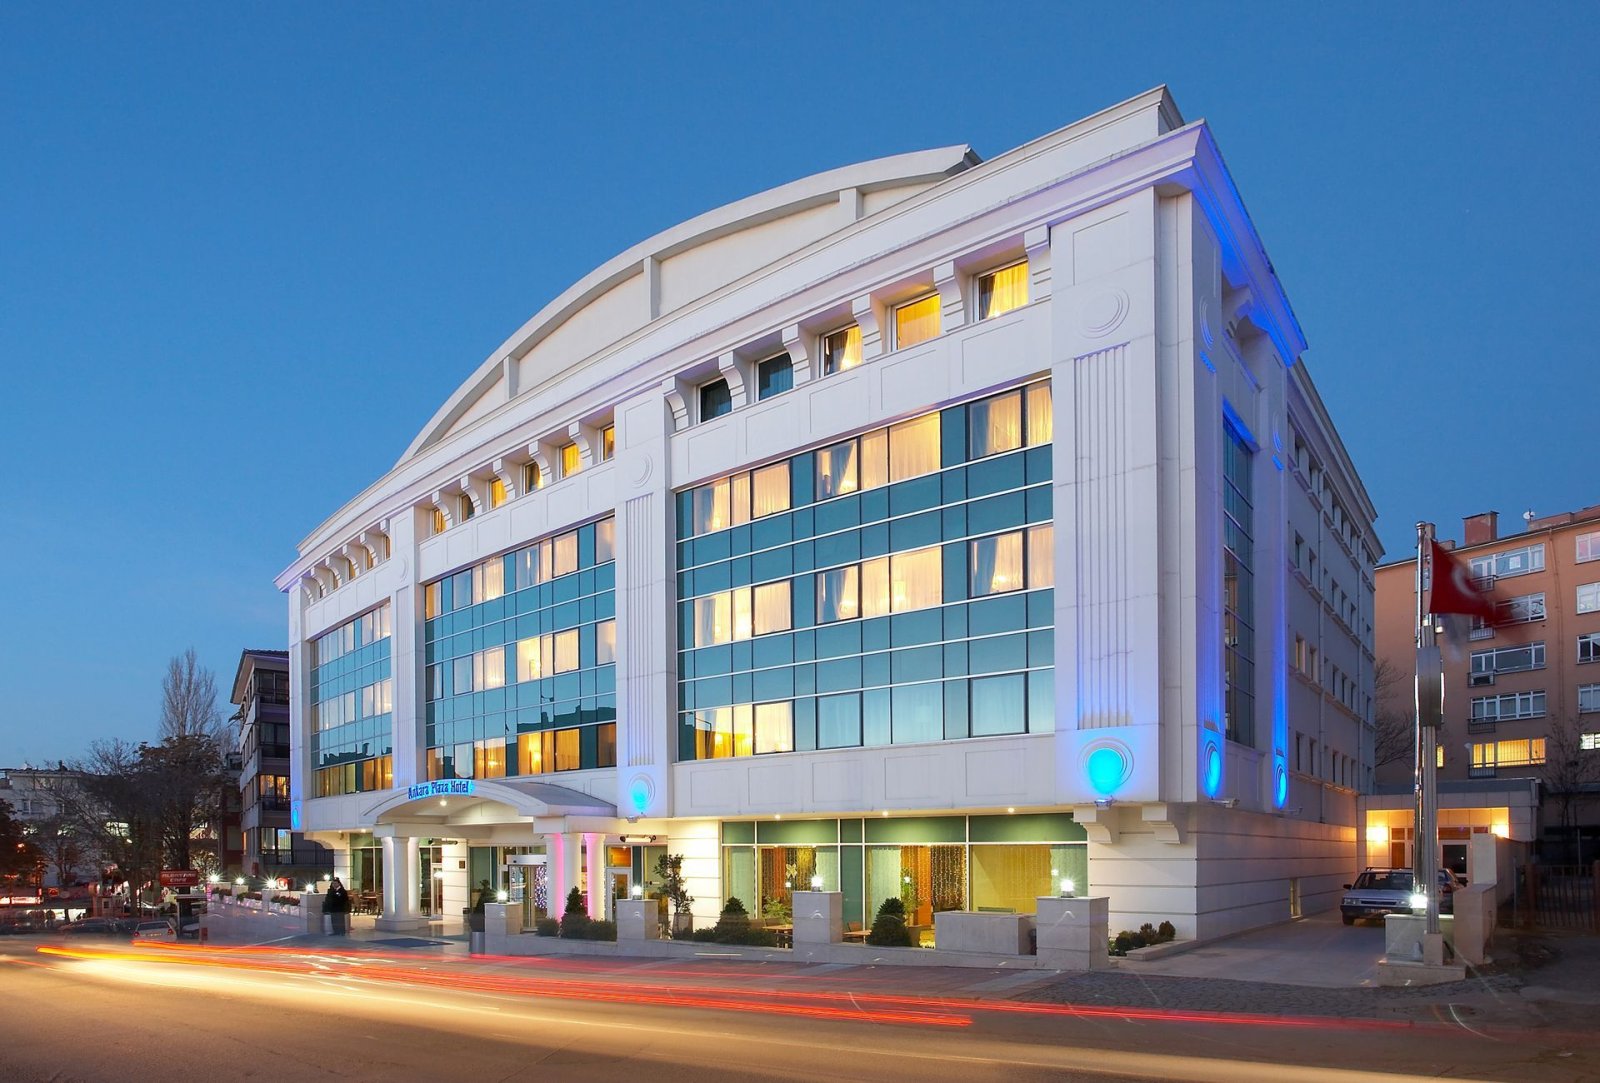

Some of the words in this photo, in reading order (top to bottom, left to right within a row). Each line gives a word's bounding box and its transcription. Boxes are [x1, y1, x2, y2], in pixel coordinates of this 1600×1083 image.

[408, 786, 429, 799] Ankara
[431, 782, 448, 794] Plaza
[450, 780, 469, 793] Hotel
